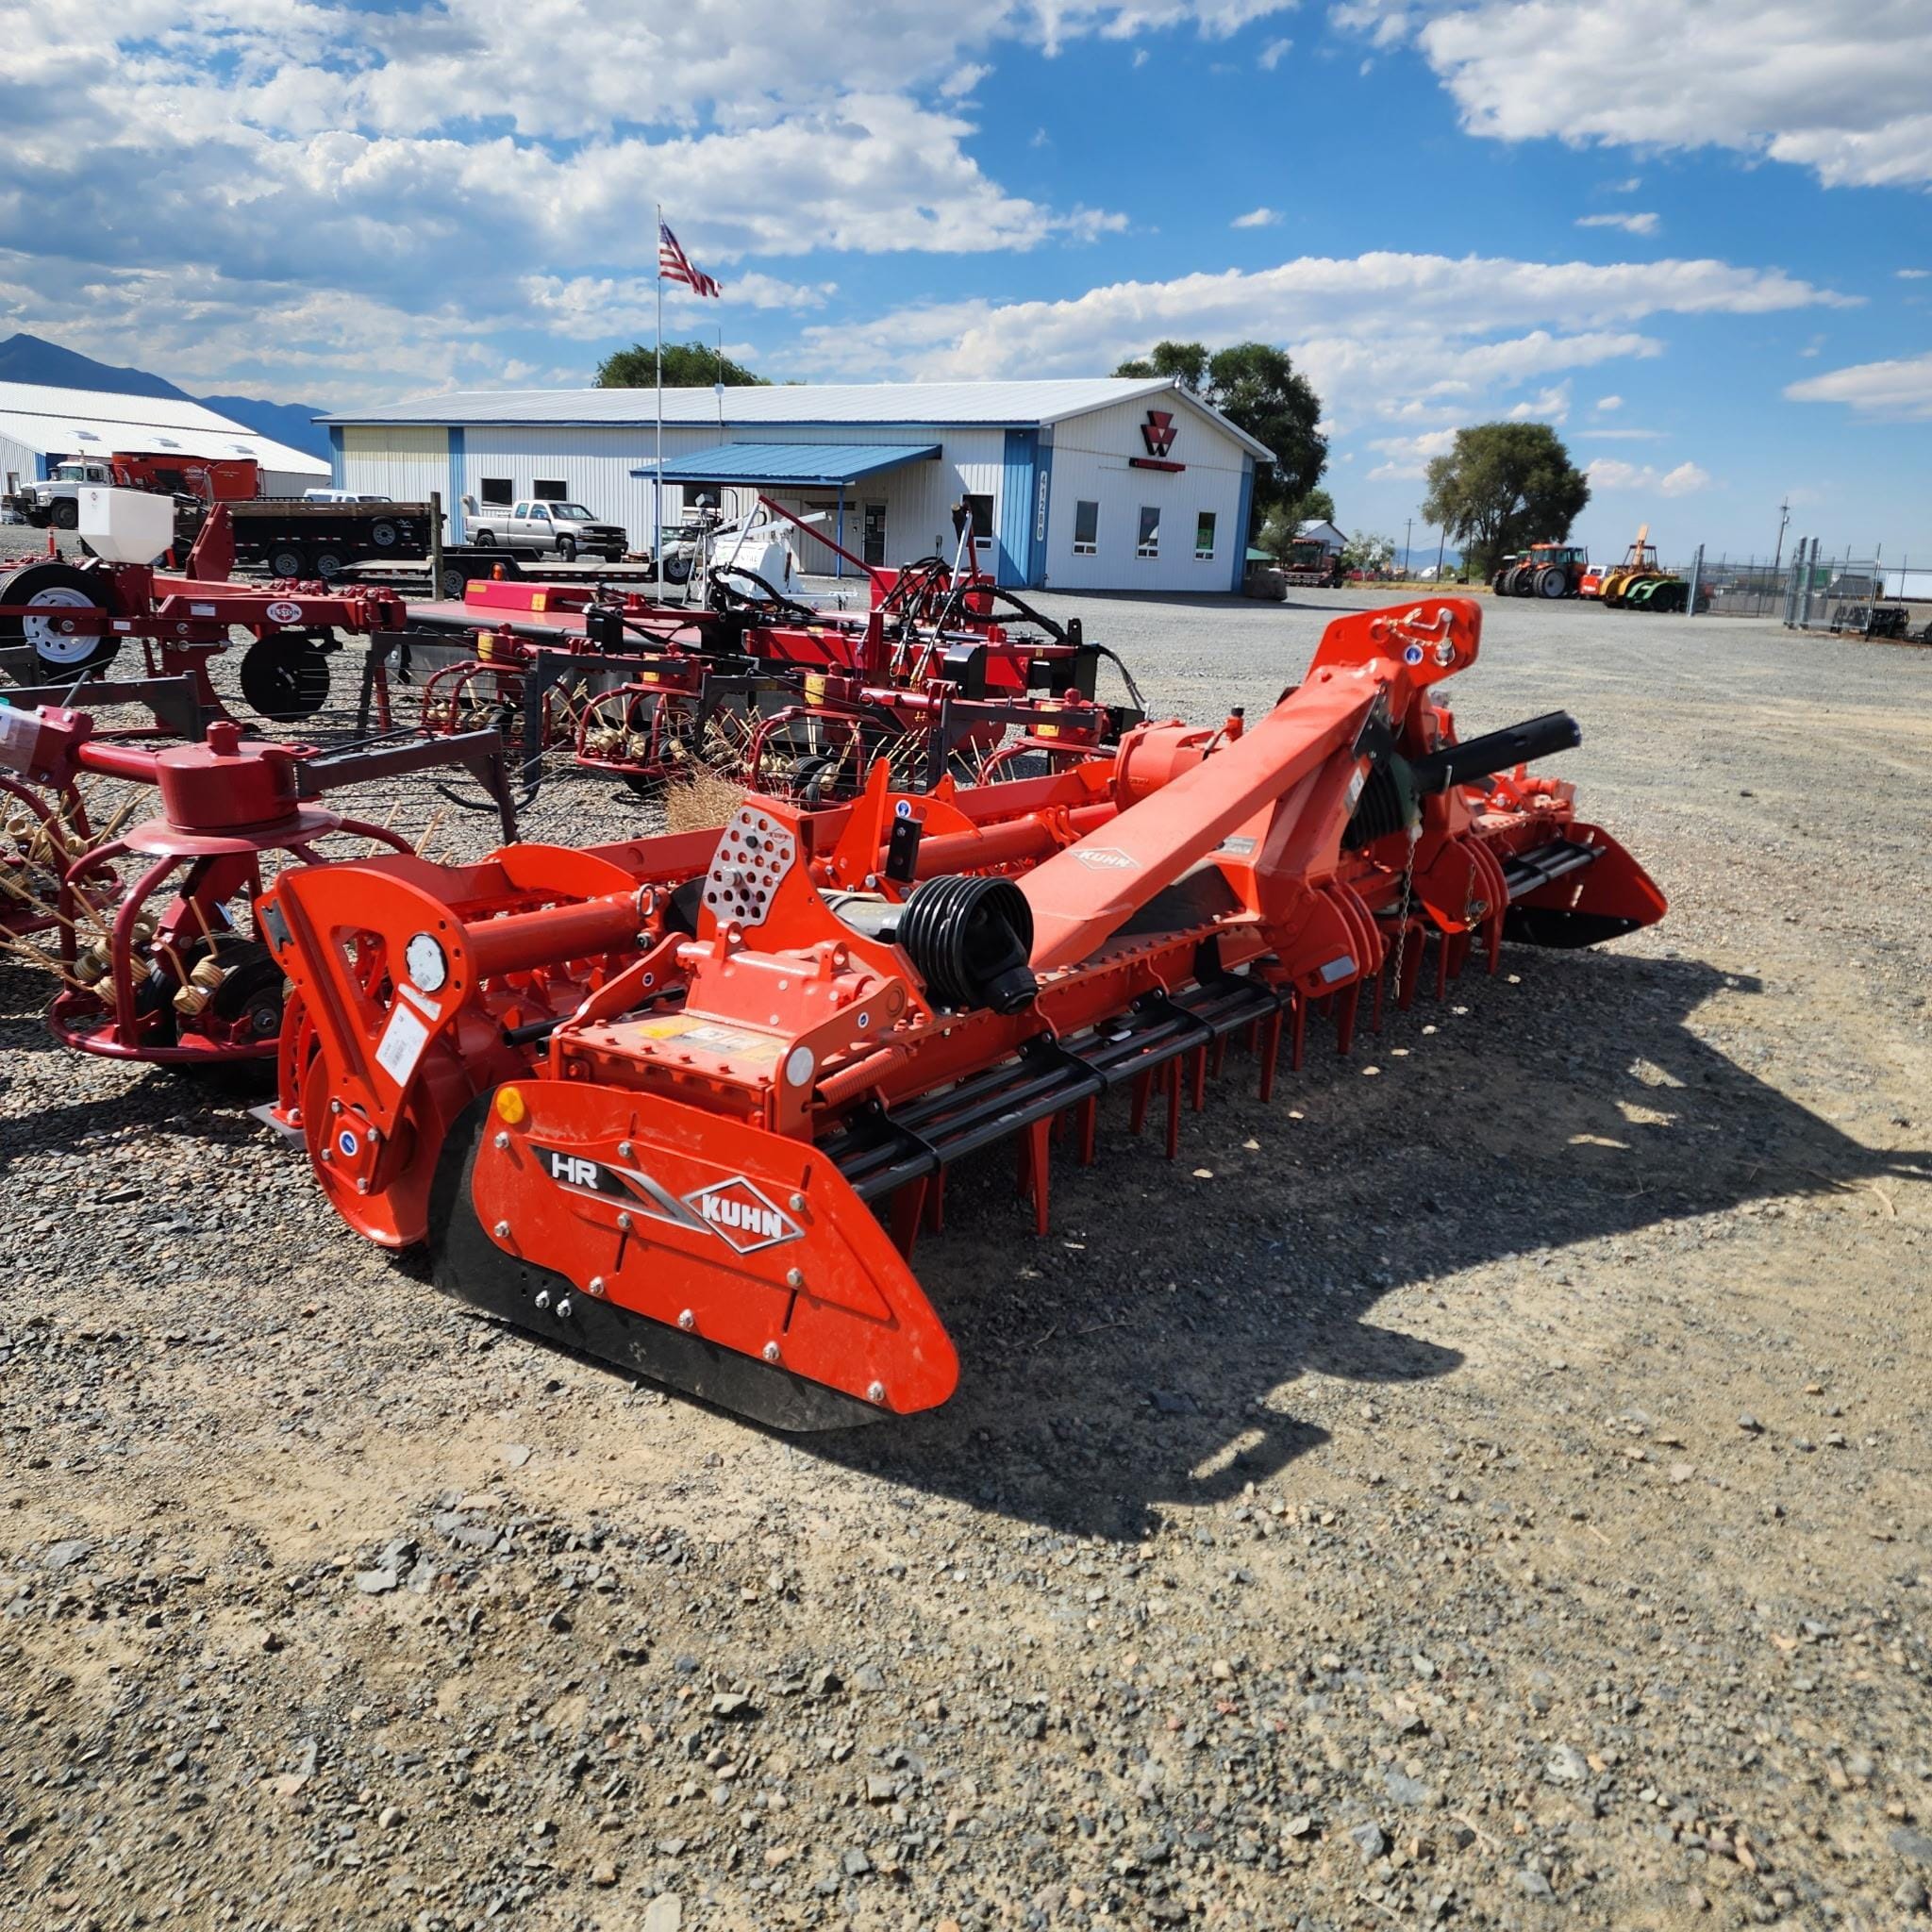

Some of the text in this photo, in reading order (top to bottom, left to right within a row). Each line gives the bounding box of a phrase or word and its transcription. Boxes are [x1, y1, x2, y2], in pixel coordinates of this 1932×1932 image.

[1038, 474, 1046, 538] 41280
[1078, 851, 1131, 867] KUHN
[552, 1153, 598, 1190] HR
[702, 1194, 782, 1240] KUHN
